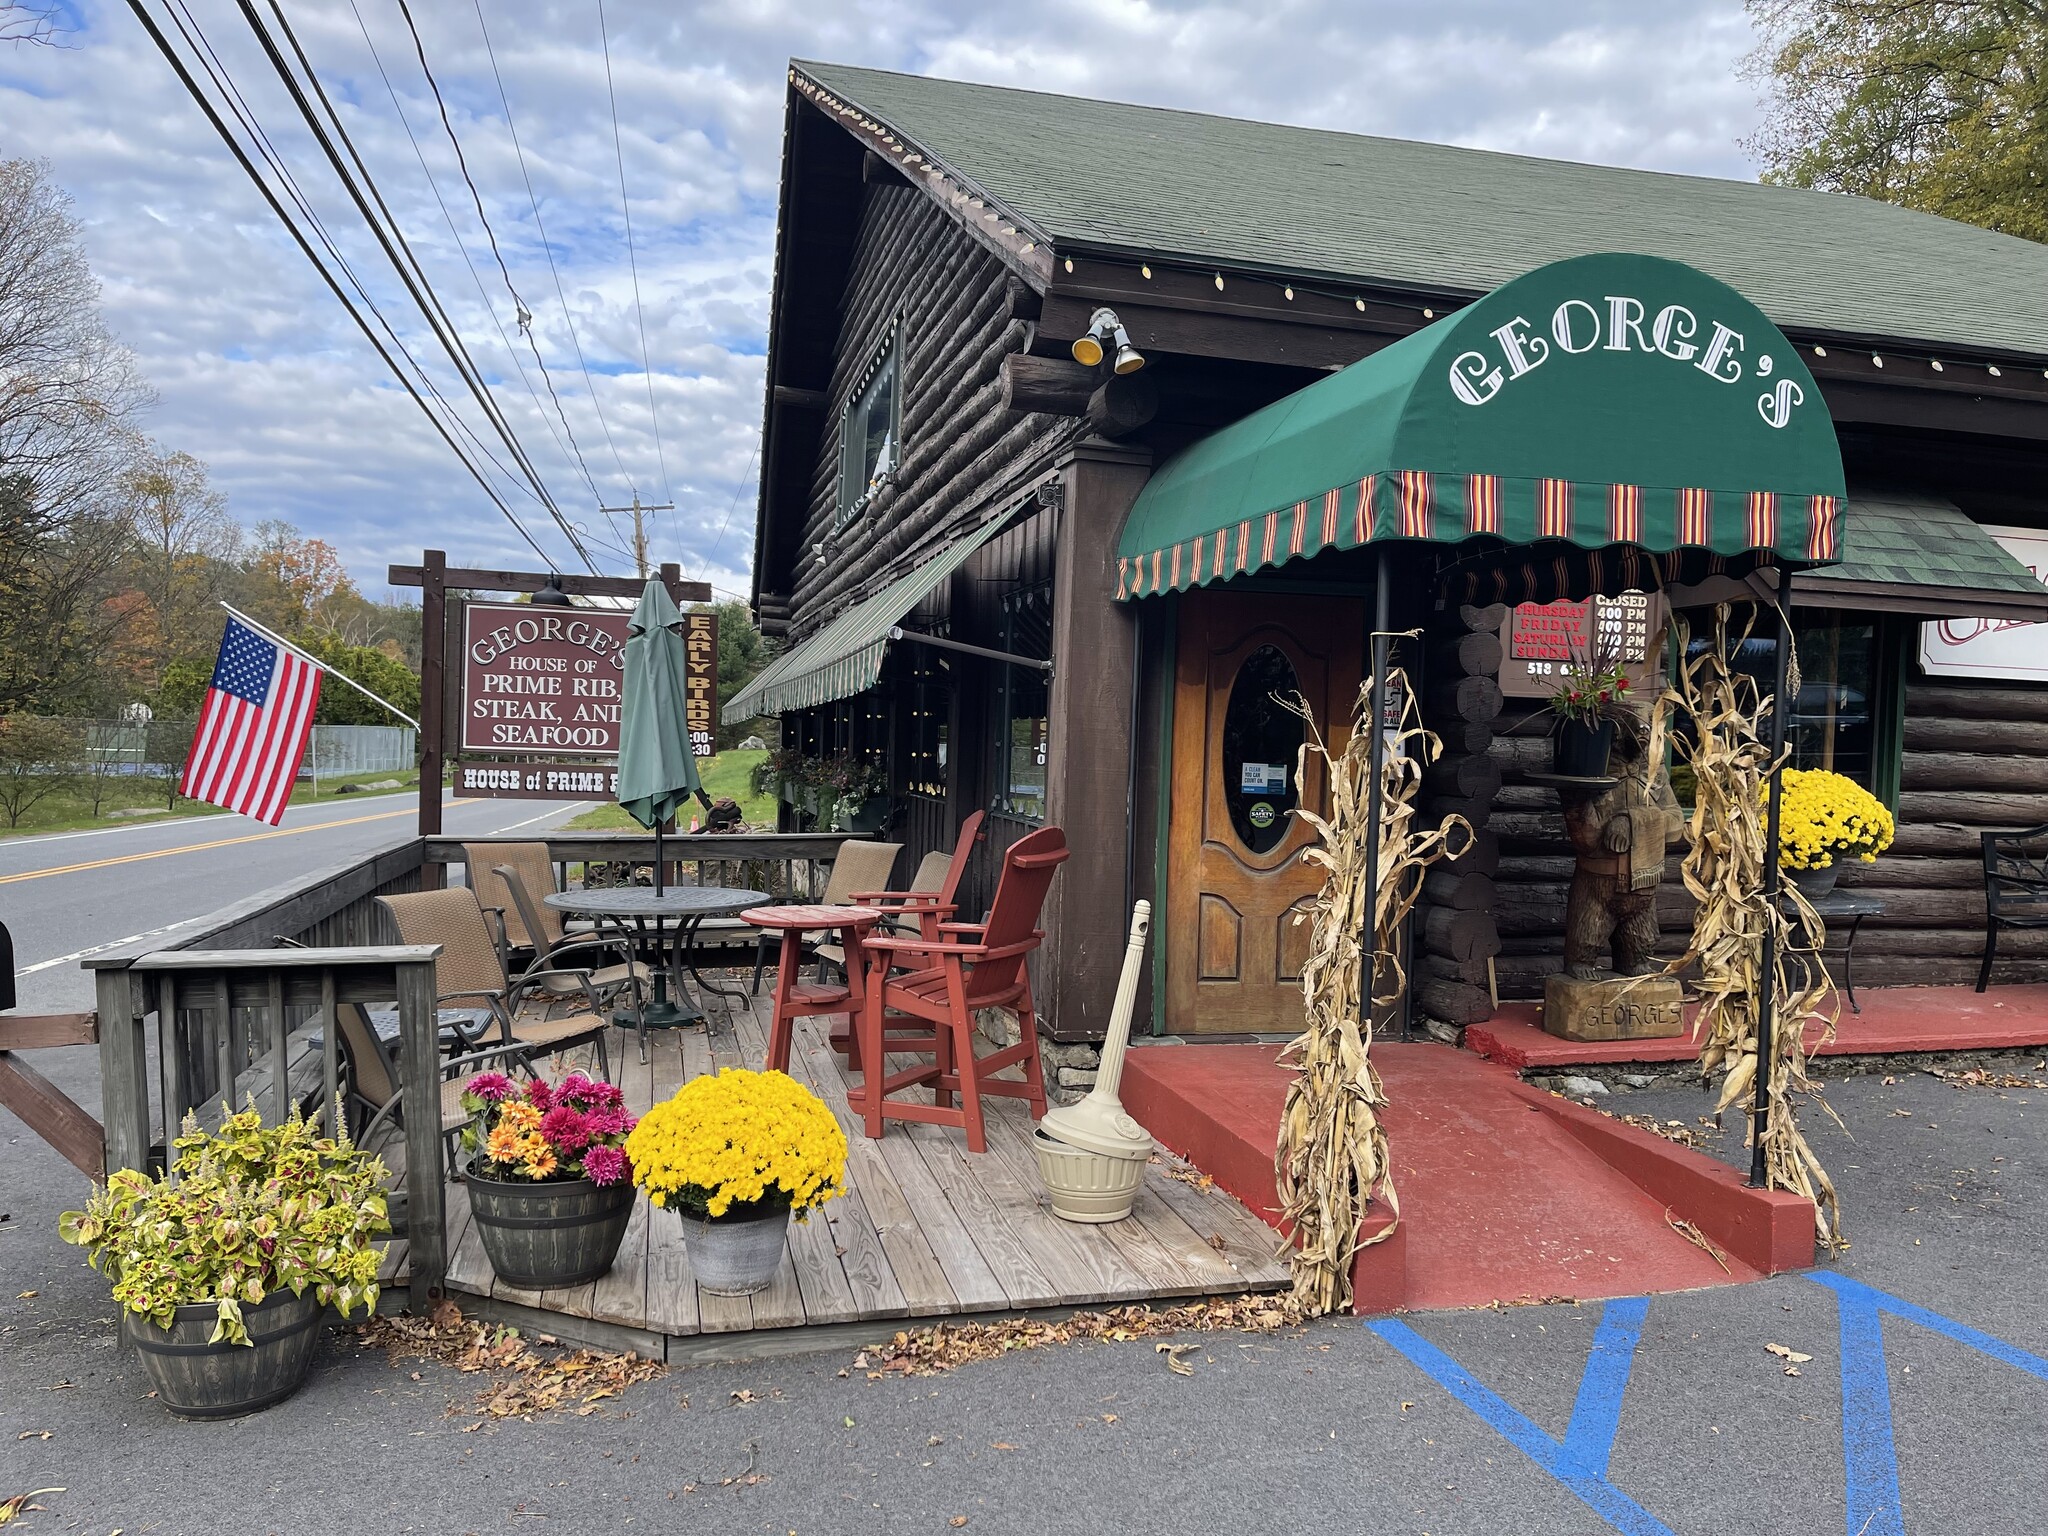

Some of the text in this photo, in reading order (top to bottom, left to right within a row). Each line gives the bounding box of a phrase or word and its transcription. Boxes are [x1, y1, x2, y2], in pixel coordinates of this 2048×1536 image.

[1449, 295, 1804, 429] GEORGE'S
[1515, 603, 1586, 618] THURSDAY
[1627, 608, 1646, 620] PM
[1520, 617, 1582, 632] FRIDAY
[1627, 622, 1646, 633] PM
[471, 617, 626, 670] GEORGE'S
[1626, 635, 1645, 647] PM
[1516, 645, 1570, 659] SUNDA
[1625, 648, 1645, 660] PM
[509, 656, 598, 673] HOUSE OF
[1527, 662, 1552, 675] 518
[686, 616, 713, 731] EARLY BIRDS
[482, 674, 622, 702] PRIME RIB,
[473, 699, 562, 724] STEAK,
[492, 724, 609, 746] SEAFOOD
[689, 731, 714, 744] :00-
[691, 744, 711, 756] :30
[463, 768, 520, 790] HOUSE
[526, 771, 541, 790] of
[546, 771, 604, 792] PRIME
